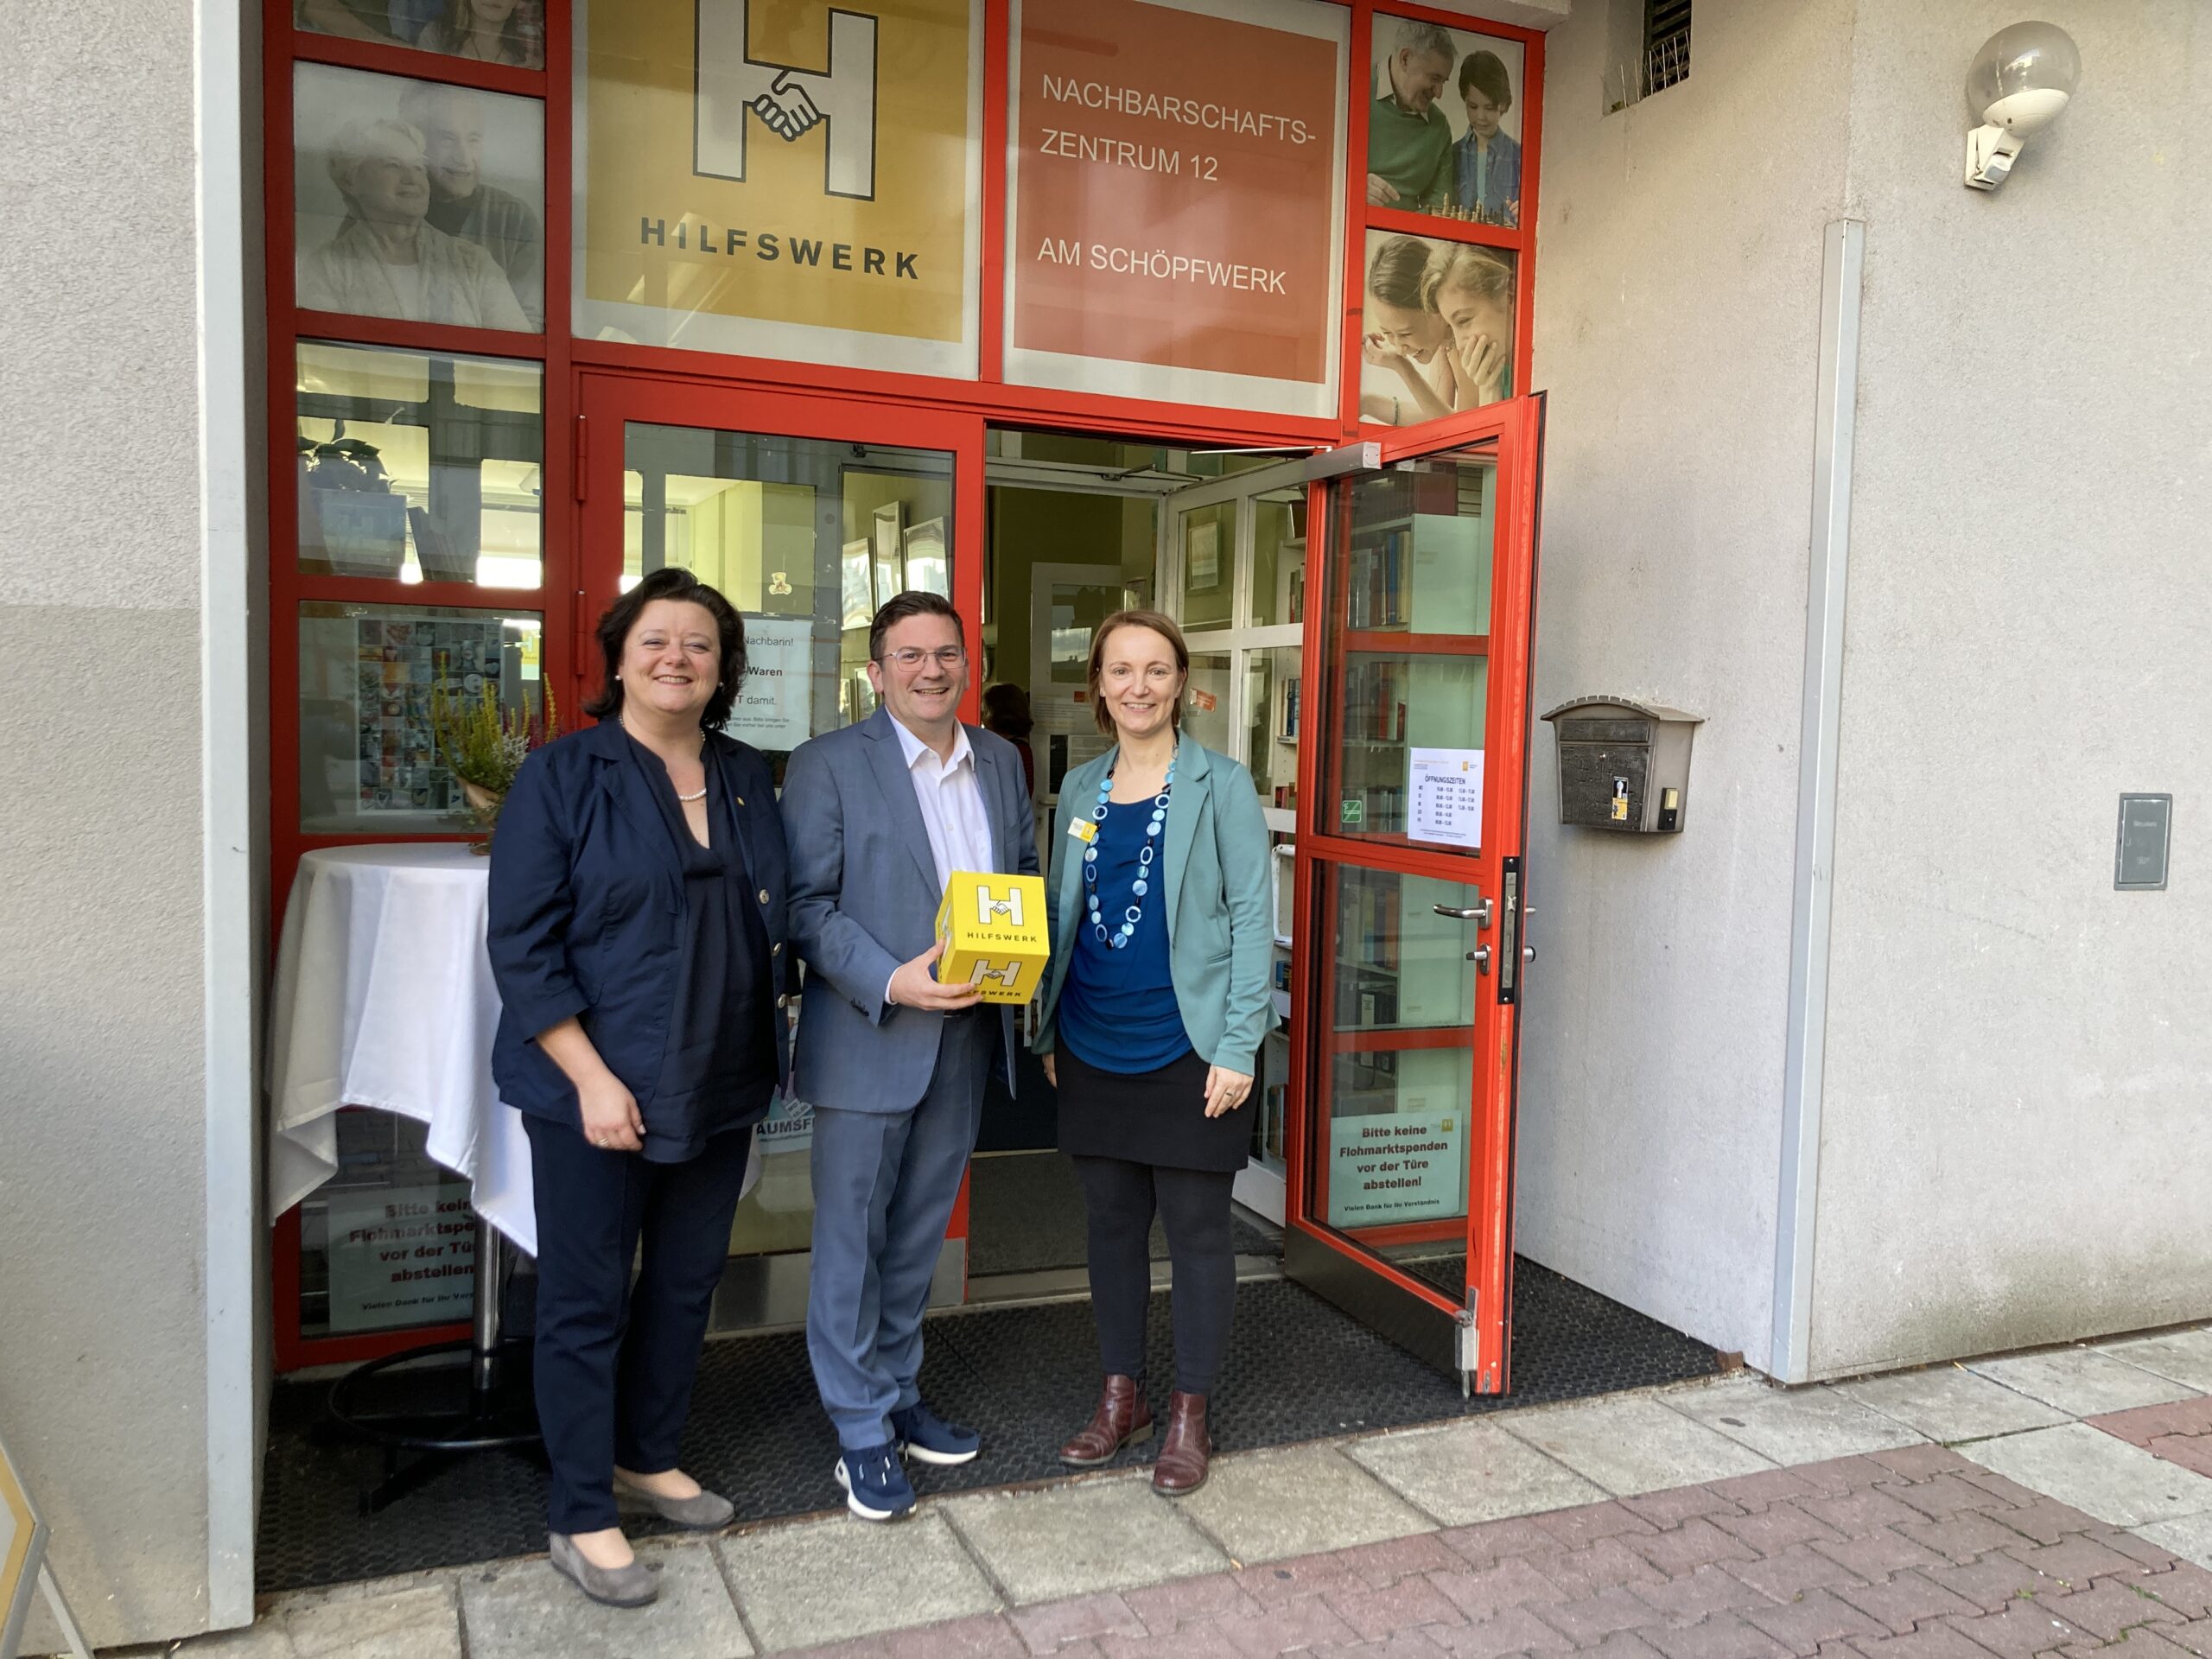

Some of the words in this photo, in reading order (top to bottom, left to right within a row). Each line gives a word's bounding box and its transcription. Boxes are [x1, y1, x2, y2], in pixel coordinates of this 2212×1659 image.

[1041, 74, 1317, 145] NACHBARSCHAFTS-
[1039, 128, 1180, 175] ZENTRUM
[1190, 154, 1218, 181] 12
[640, 216, 919, 281] HILFSWERK
[1037, 237, 1081, 266] AM
[1090, 245, 1287, 296] SCHÖPFWERK
[747, 695, 778, 706] damit.
[1424, 774, 1466, 785] ÖFFNUNGSZEITEN
[967, 931, 1038, 943] HILFSWERK
[756, 1117, 816, 1135] AUMSF
[1362, 1127, 1391, 1138] Bitte
[1395, 1125, 1427, 1137] keine
[1339, 1141, 1448, 1158] Flohmarktspenden
[1357, 1164, 1376, 1173] vor
[1379, 1161, 1400, 1173] der
[1403, 1159, 1429, 1171] Türe
[1363, 1176, 1422, 1191] abstellen!
[385, 1203, 429, 1219] Bitte
[435, 1198, 472, 1214] kein
[1404, 1198, 1440, 1208] Verständnis
[348, 1221, 474, 1243] Flohmarktspe
[379, 1249, 410, 1262] vor
[415, 1245, 444, 1259] der
[449, 1241, 474, 1255] Tü
[391, 1263, 474, 1283] abstellen
